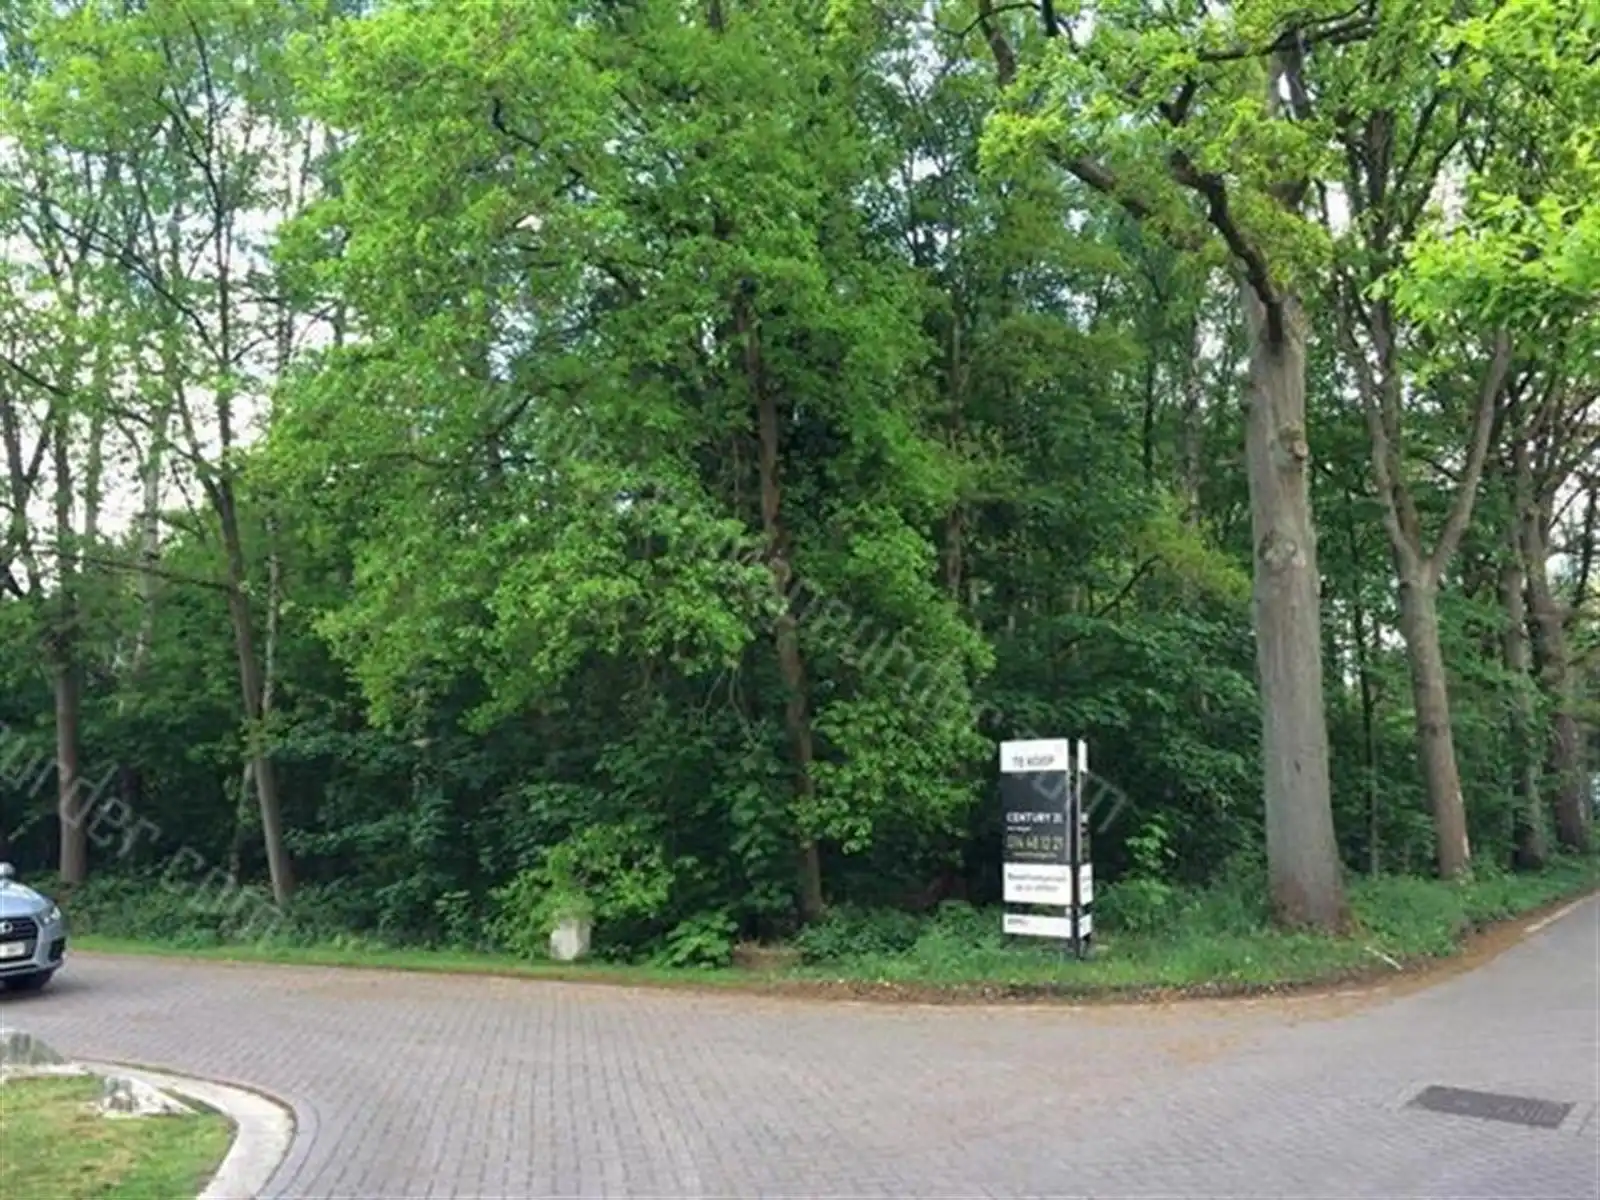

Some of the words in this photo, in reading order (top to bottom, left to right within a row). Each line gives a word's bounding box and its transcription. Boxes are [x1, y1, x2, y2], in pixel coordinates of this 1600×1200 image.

[1012, 755, 1025, 767] TE
[1027, 754, 1055, 767] KOOP
[1006, 811, 1051, 824] CENTURY
